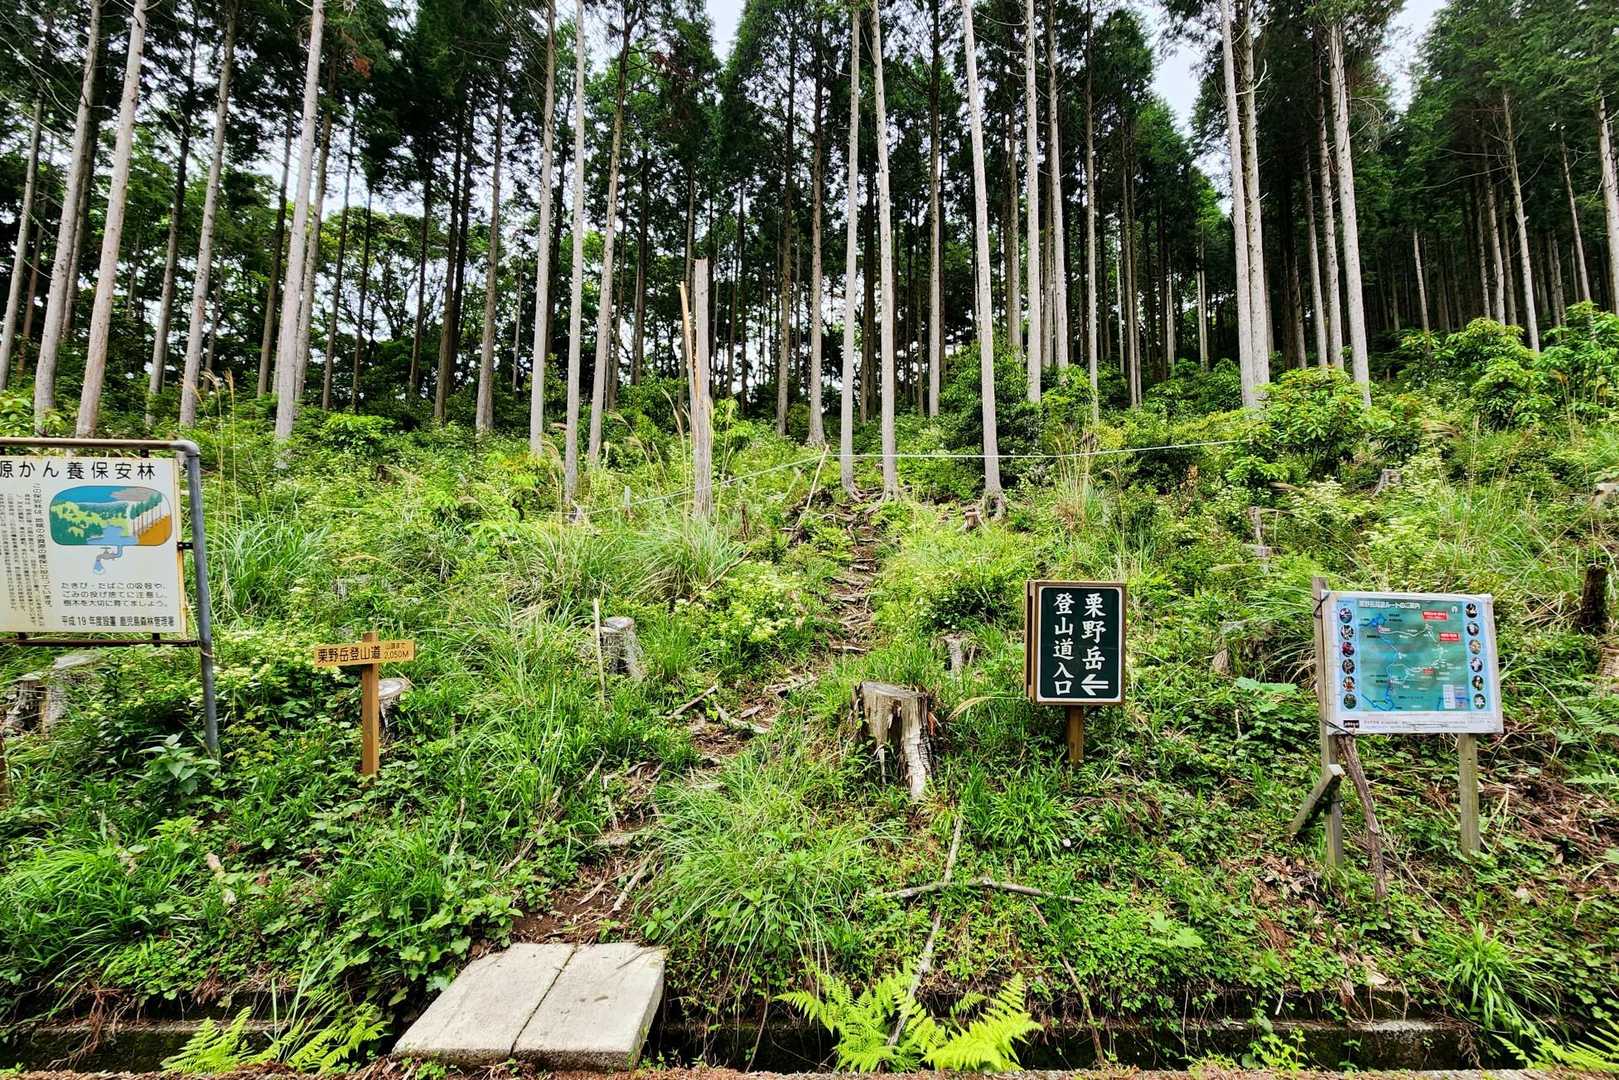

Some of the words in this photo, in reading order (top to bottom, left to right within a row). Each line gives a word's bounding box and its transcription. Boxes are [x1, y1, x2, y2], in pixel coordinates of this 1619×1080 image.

[0, 460, 156, 479] 原かん養保安林
[318, 646, 380, 663] 栗野岳登山道
[1053, 592, 1076, 695] 登山道入口
[1081, 592, 1107, 671] 栗野岳
